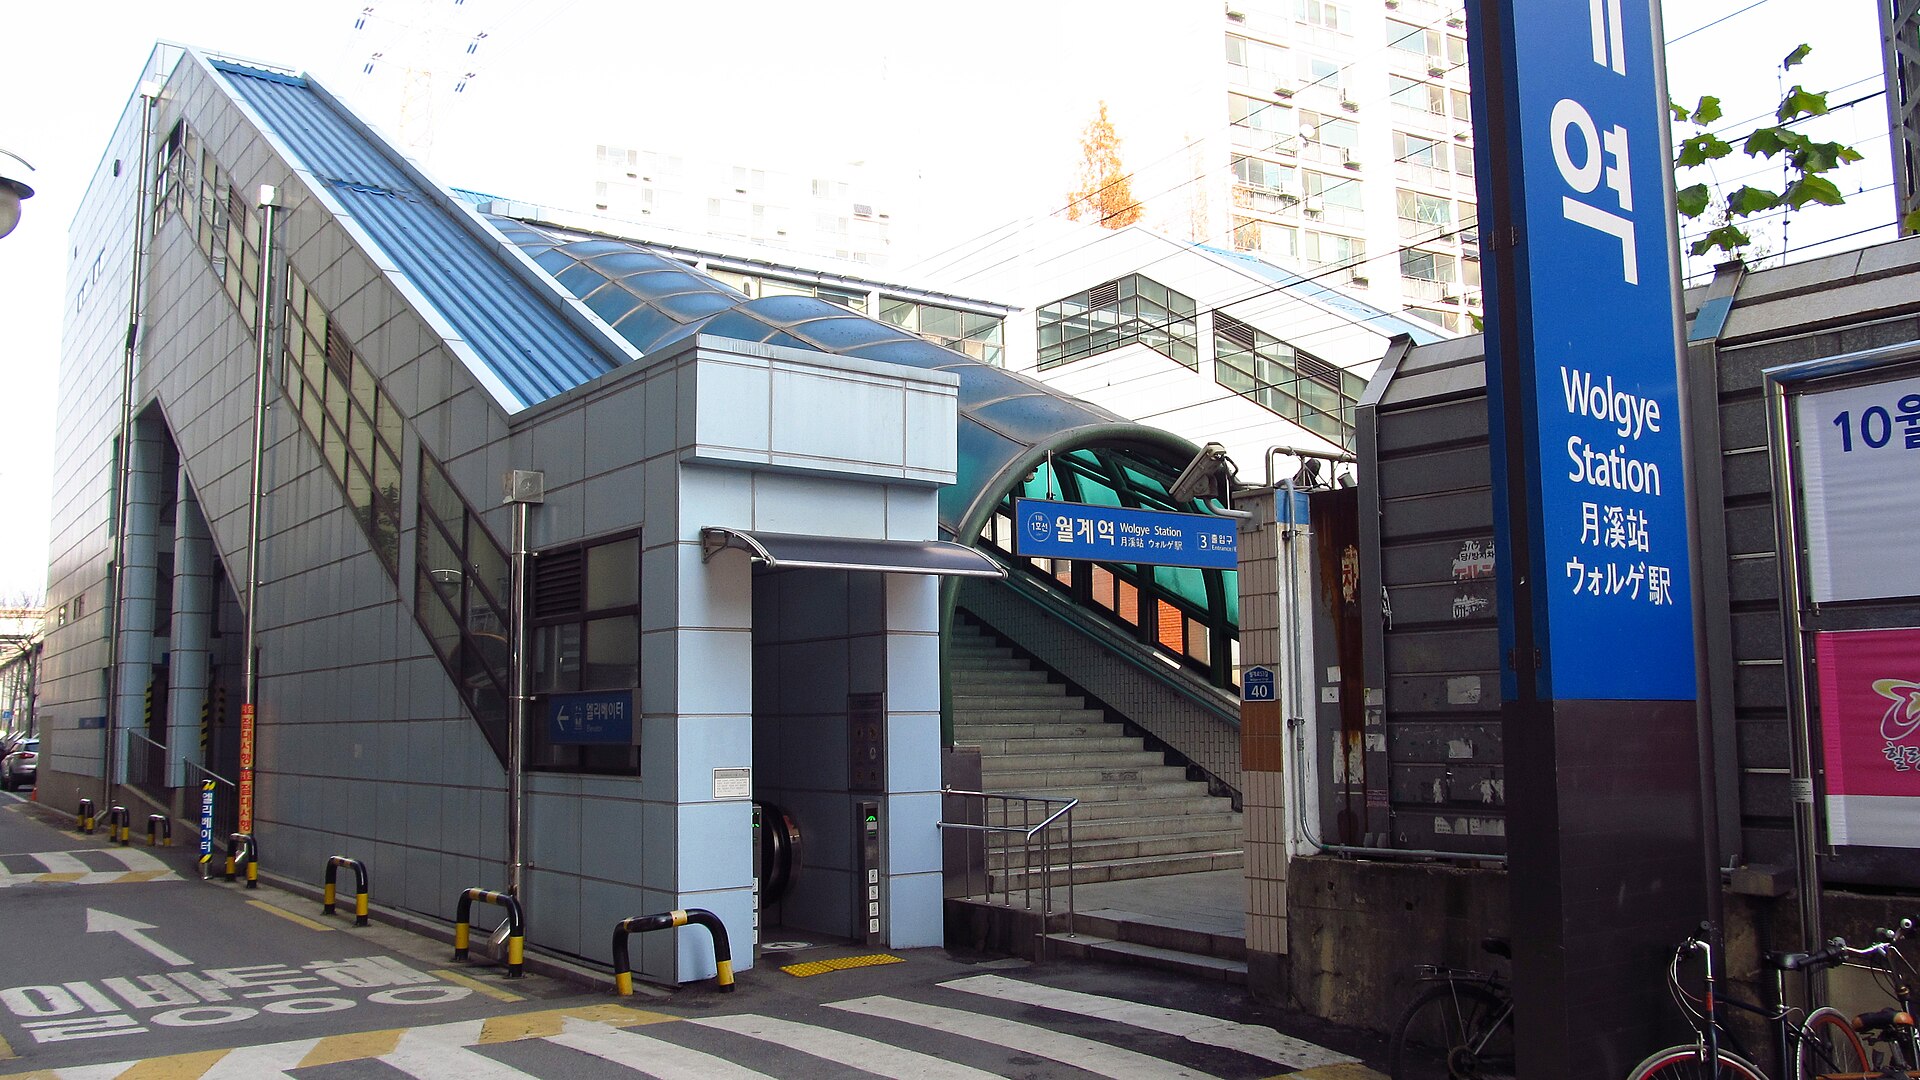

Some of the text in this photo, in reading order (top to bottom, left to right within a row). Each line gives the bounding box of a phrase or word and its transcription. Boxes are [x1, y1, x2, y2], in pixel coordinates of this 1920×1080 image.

[1550, 0, 1639, 285] 역
[1560, 366, 1661, 441] Wolgye
[1567, 435, 1661, 496] Station
[1031, 522, 1048, 533] 1호선
[1056, 516, 1115, 546] 월계역
[1119, 523, 1182, 537] Wolgye Station
[1120, 536, 1144, 548] 月溪站
[1200, 534, 1208, 549] 3
[1580, 501, 1649, 553] 月溪站
[1565, 556, 1673, 606] ウォルゲ駅
[586, 701, 624, 720] 엘리베이터
[1251, 684, 1268, 698] 40
[240, 716, 252, 765] 절대서행
[200, 791, 213, 853] 엘리베이터
[239, 784, 252, 832] 절대서행
[0, 955, 473, 1044] 일방통행
